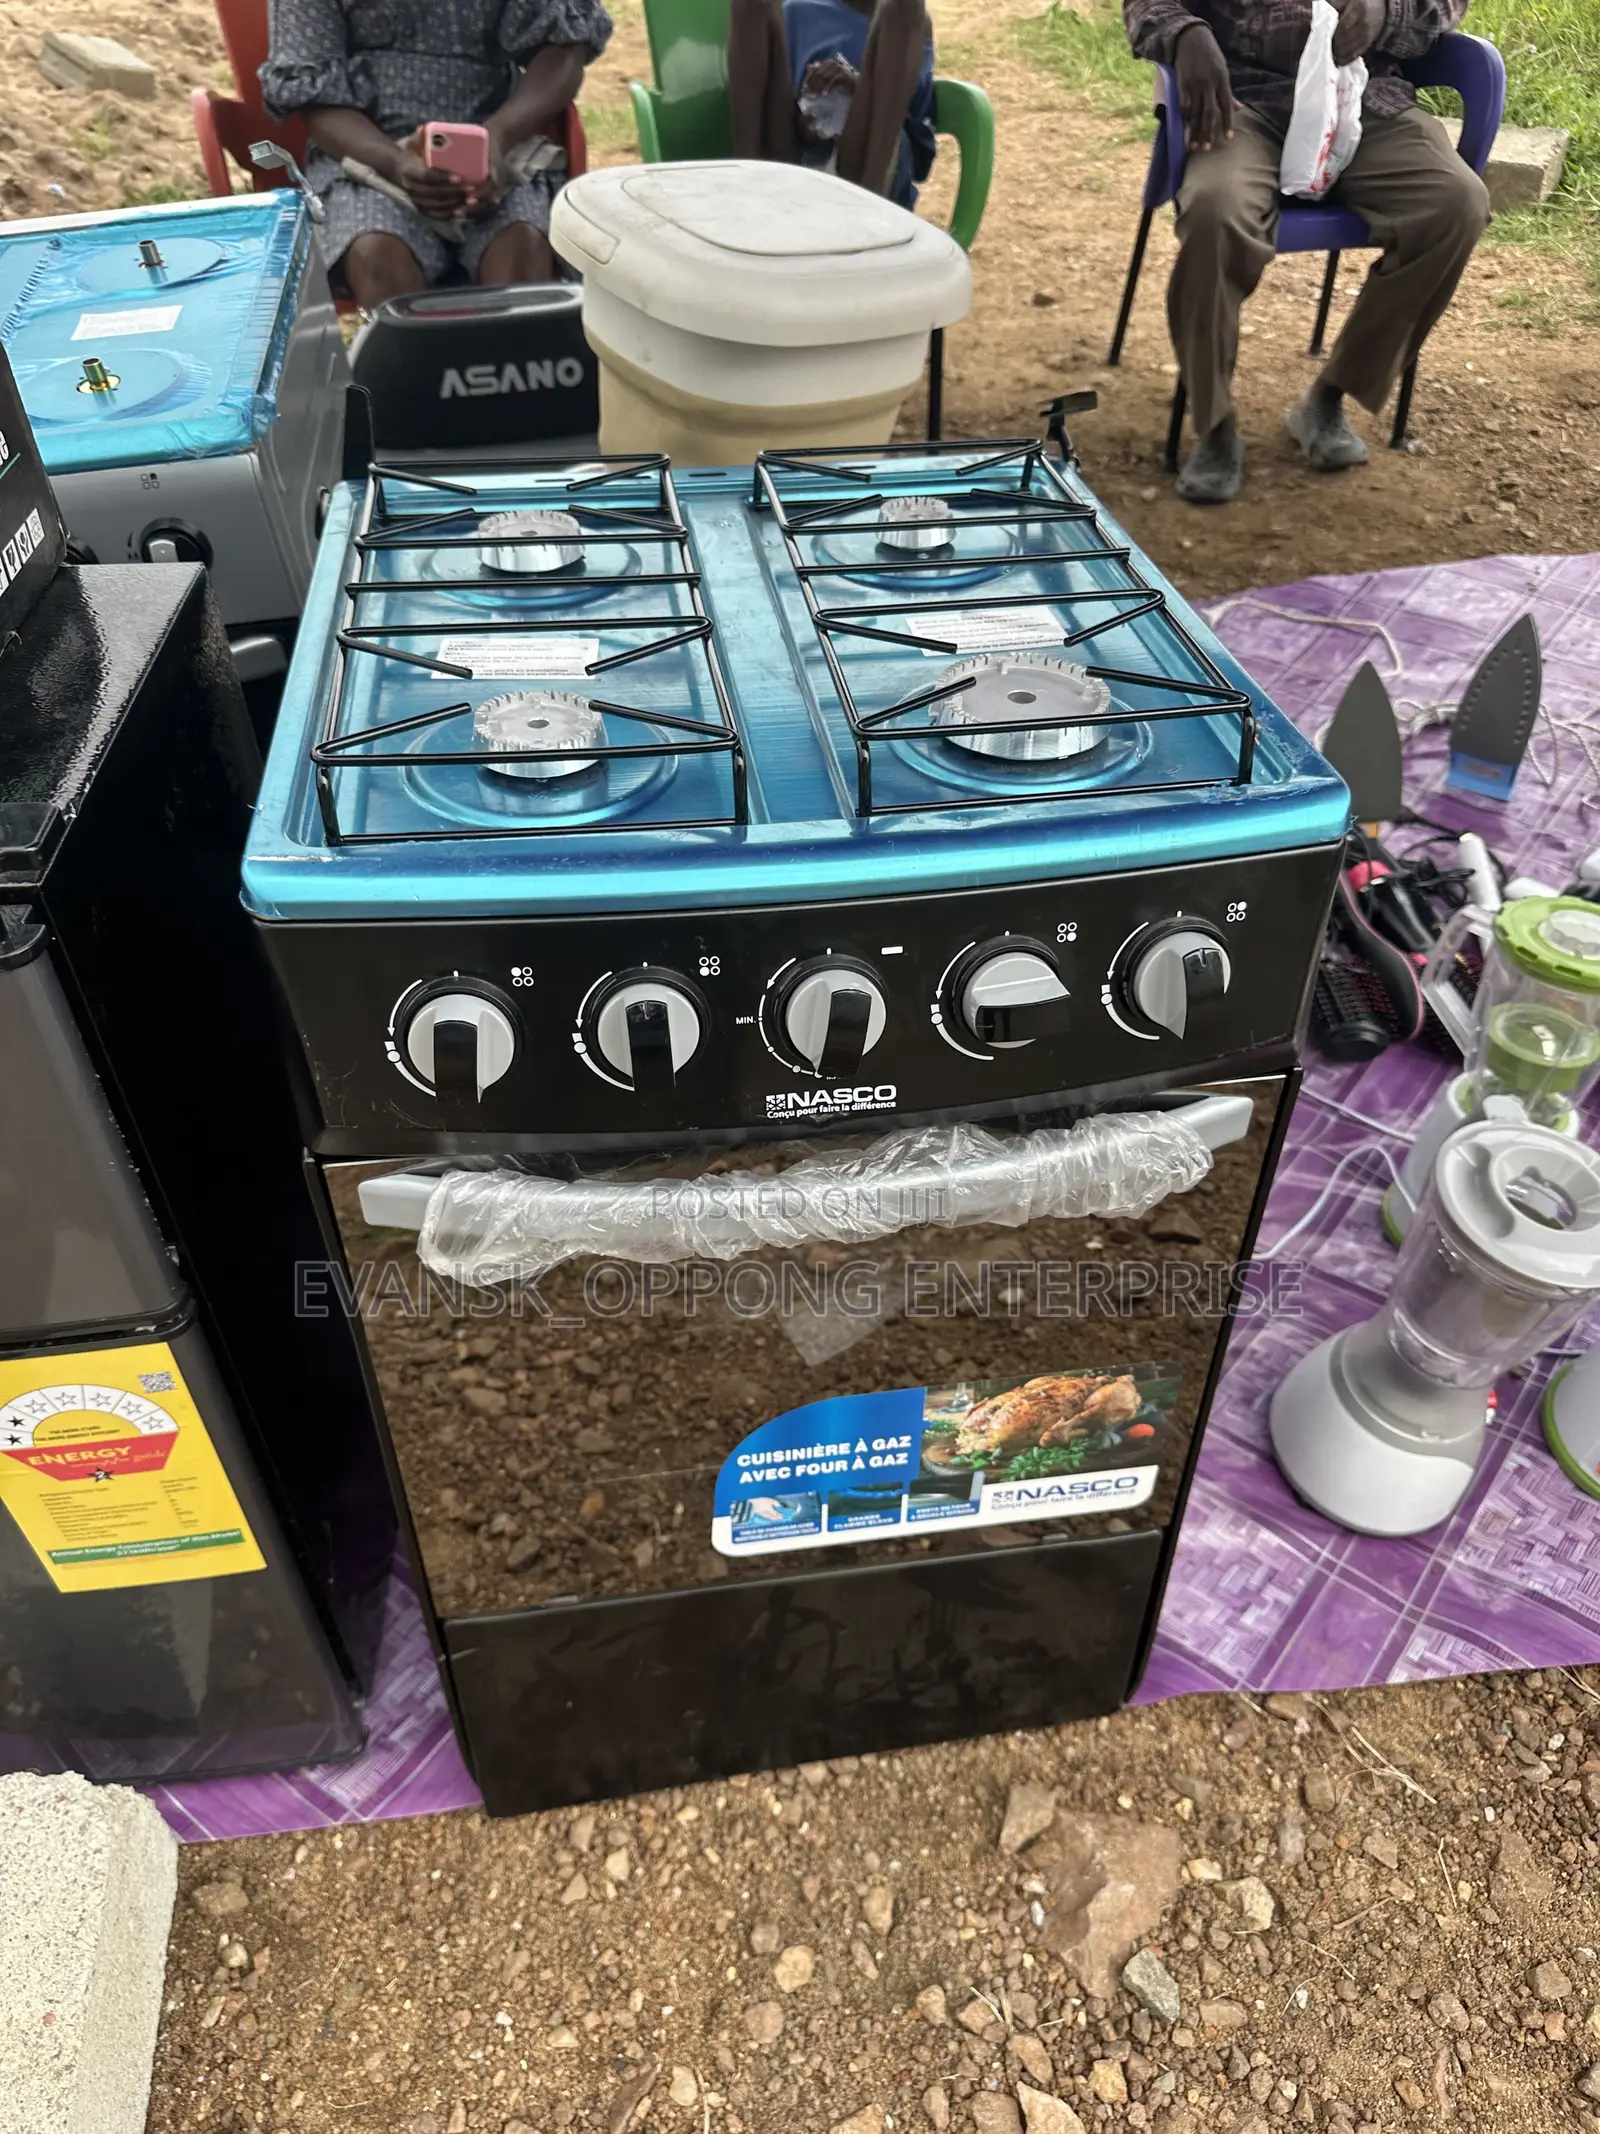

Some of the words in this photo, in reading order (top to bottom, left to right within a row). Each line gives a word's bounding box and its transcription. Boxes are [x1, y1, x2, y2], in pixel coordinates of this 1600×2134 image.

[439, 356, 584, 399] ASANO
[735, 1015, 757, 1025] MIN.
[787, 1084, 897, 1109] NASCO
[766, 1110, 796, 1120] Conçu
[796, 1106, 818, 1118] pour
[819, 1104, 840, 1113] faire
[842, 1102, 850, 1112] la
[851, 1100, 896, 1111] différence
[28, 1445, 132, 1466] ENERGY
[737, 1443, 851, 1467] CUISINIÈRE
[854, 1438, 868, 1453] À
[872, 1435, 912, 1450] GAZ
[739, 1467, 791, 1484] AVEC
[795, 1460, 848, 1477] FOUR
[852, 1455, 865, 1470] À
[869, 1453, 908, 1468] GAZ
[1016, 1476, 1139, 1501] NASCO
